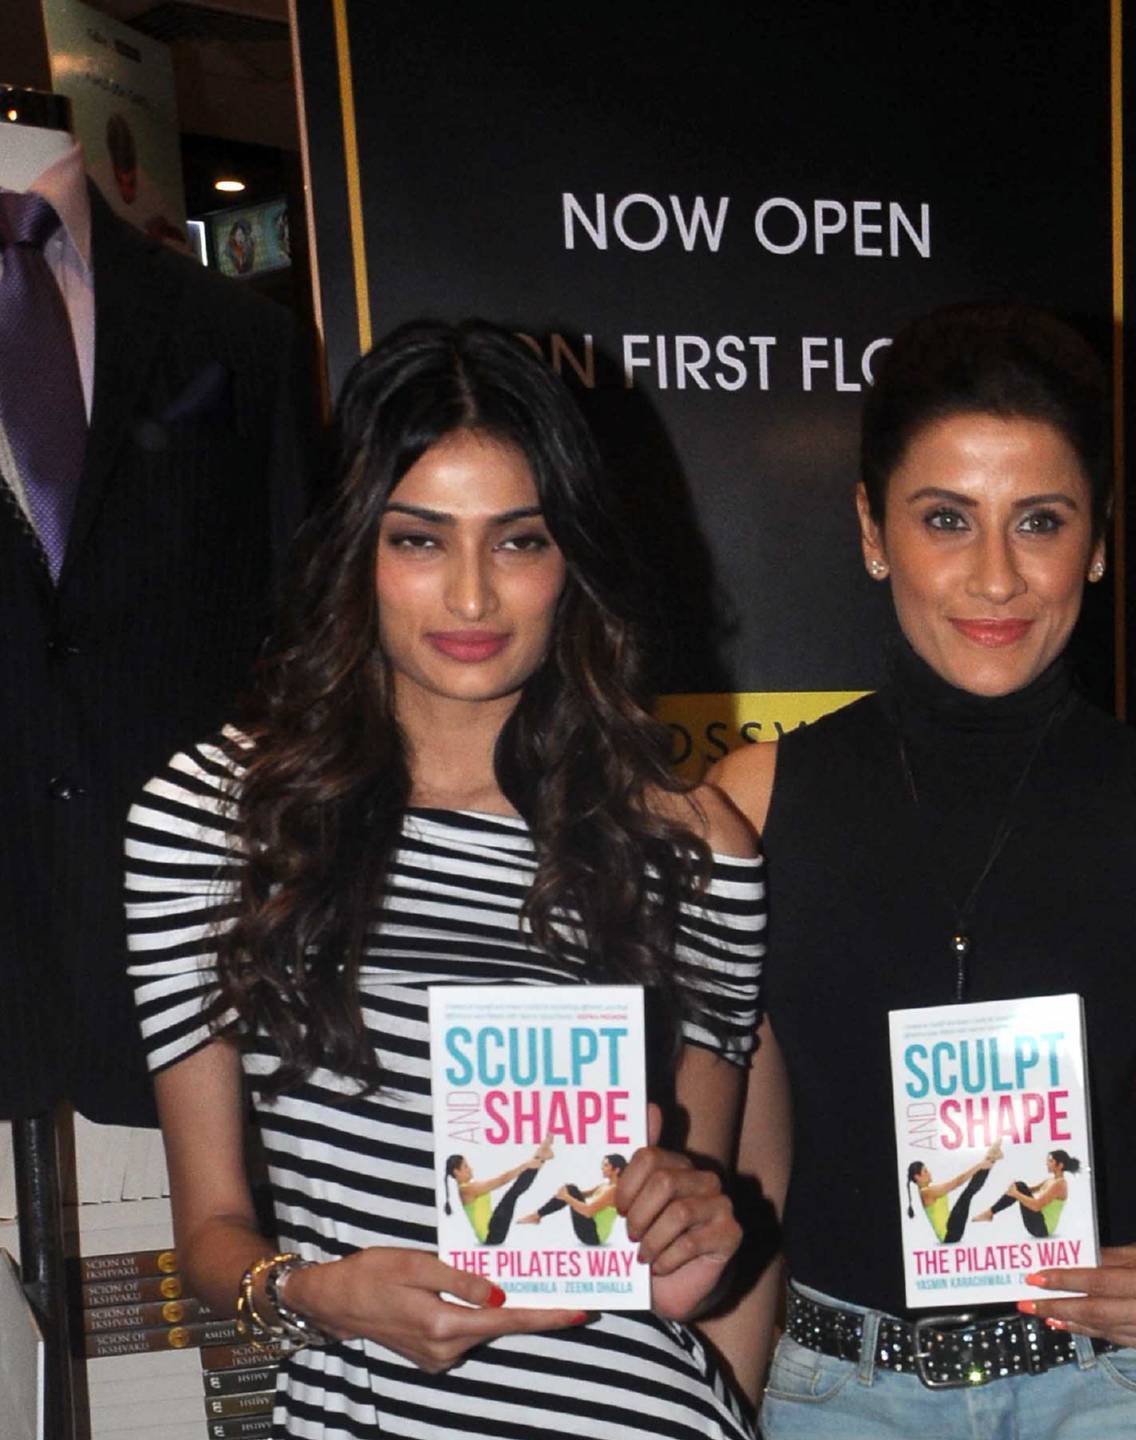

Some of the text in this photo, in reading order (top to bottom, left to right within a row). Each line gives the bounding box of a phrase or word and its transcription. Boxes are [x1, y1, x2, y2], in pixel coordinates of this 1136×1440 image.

[562, 192, 931, 258] NOW OPEN
[622, 334, 777, 392] FIRST
[445, 1026, 628, 1086] SCULPT
[904, 1032, 1065, 1099] SCULPT
[446, 1090, 480, 1145] AND
[483, 1090, 630, 1145] SHAPE
[906, 1101, 937, 1151] AND
[939, 1090, 1072, 1151] SHAPE
[85, 1258, 120, 1269] SCION
[450, 1251, 635, 1278] THE PILATES WAY
[913, 1240, 1082, 1276] THE PILATES WAY
[91, 1307, 141, 1320] SCION OF
[91, 1315, 145, 1330] IKSHVAKU
[204, 1329, 236, 1340] AMISH
[96, 1331, 147, 1346] SCION OF
[231, 1353, 277, 1367] IKSHVAK
